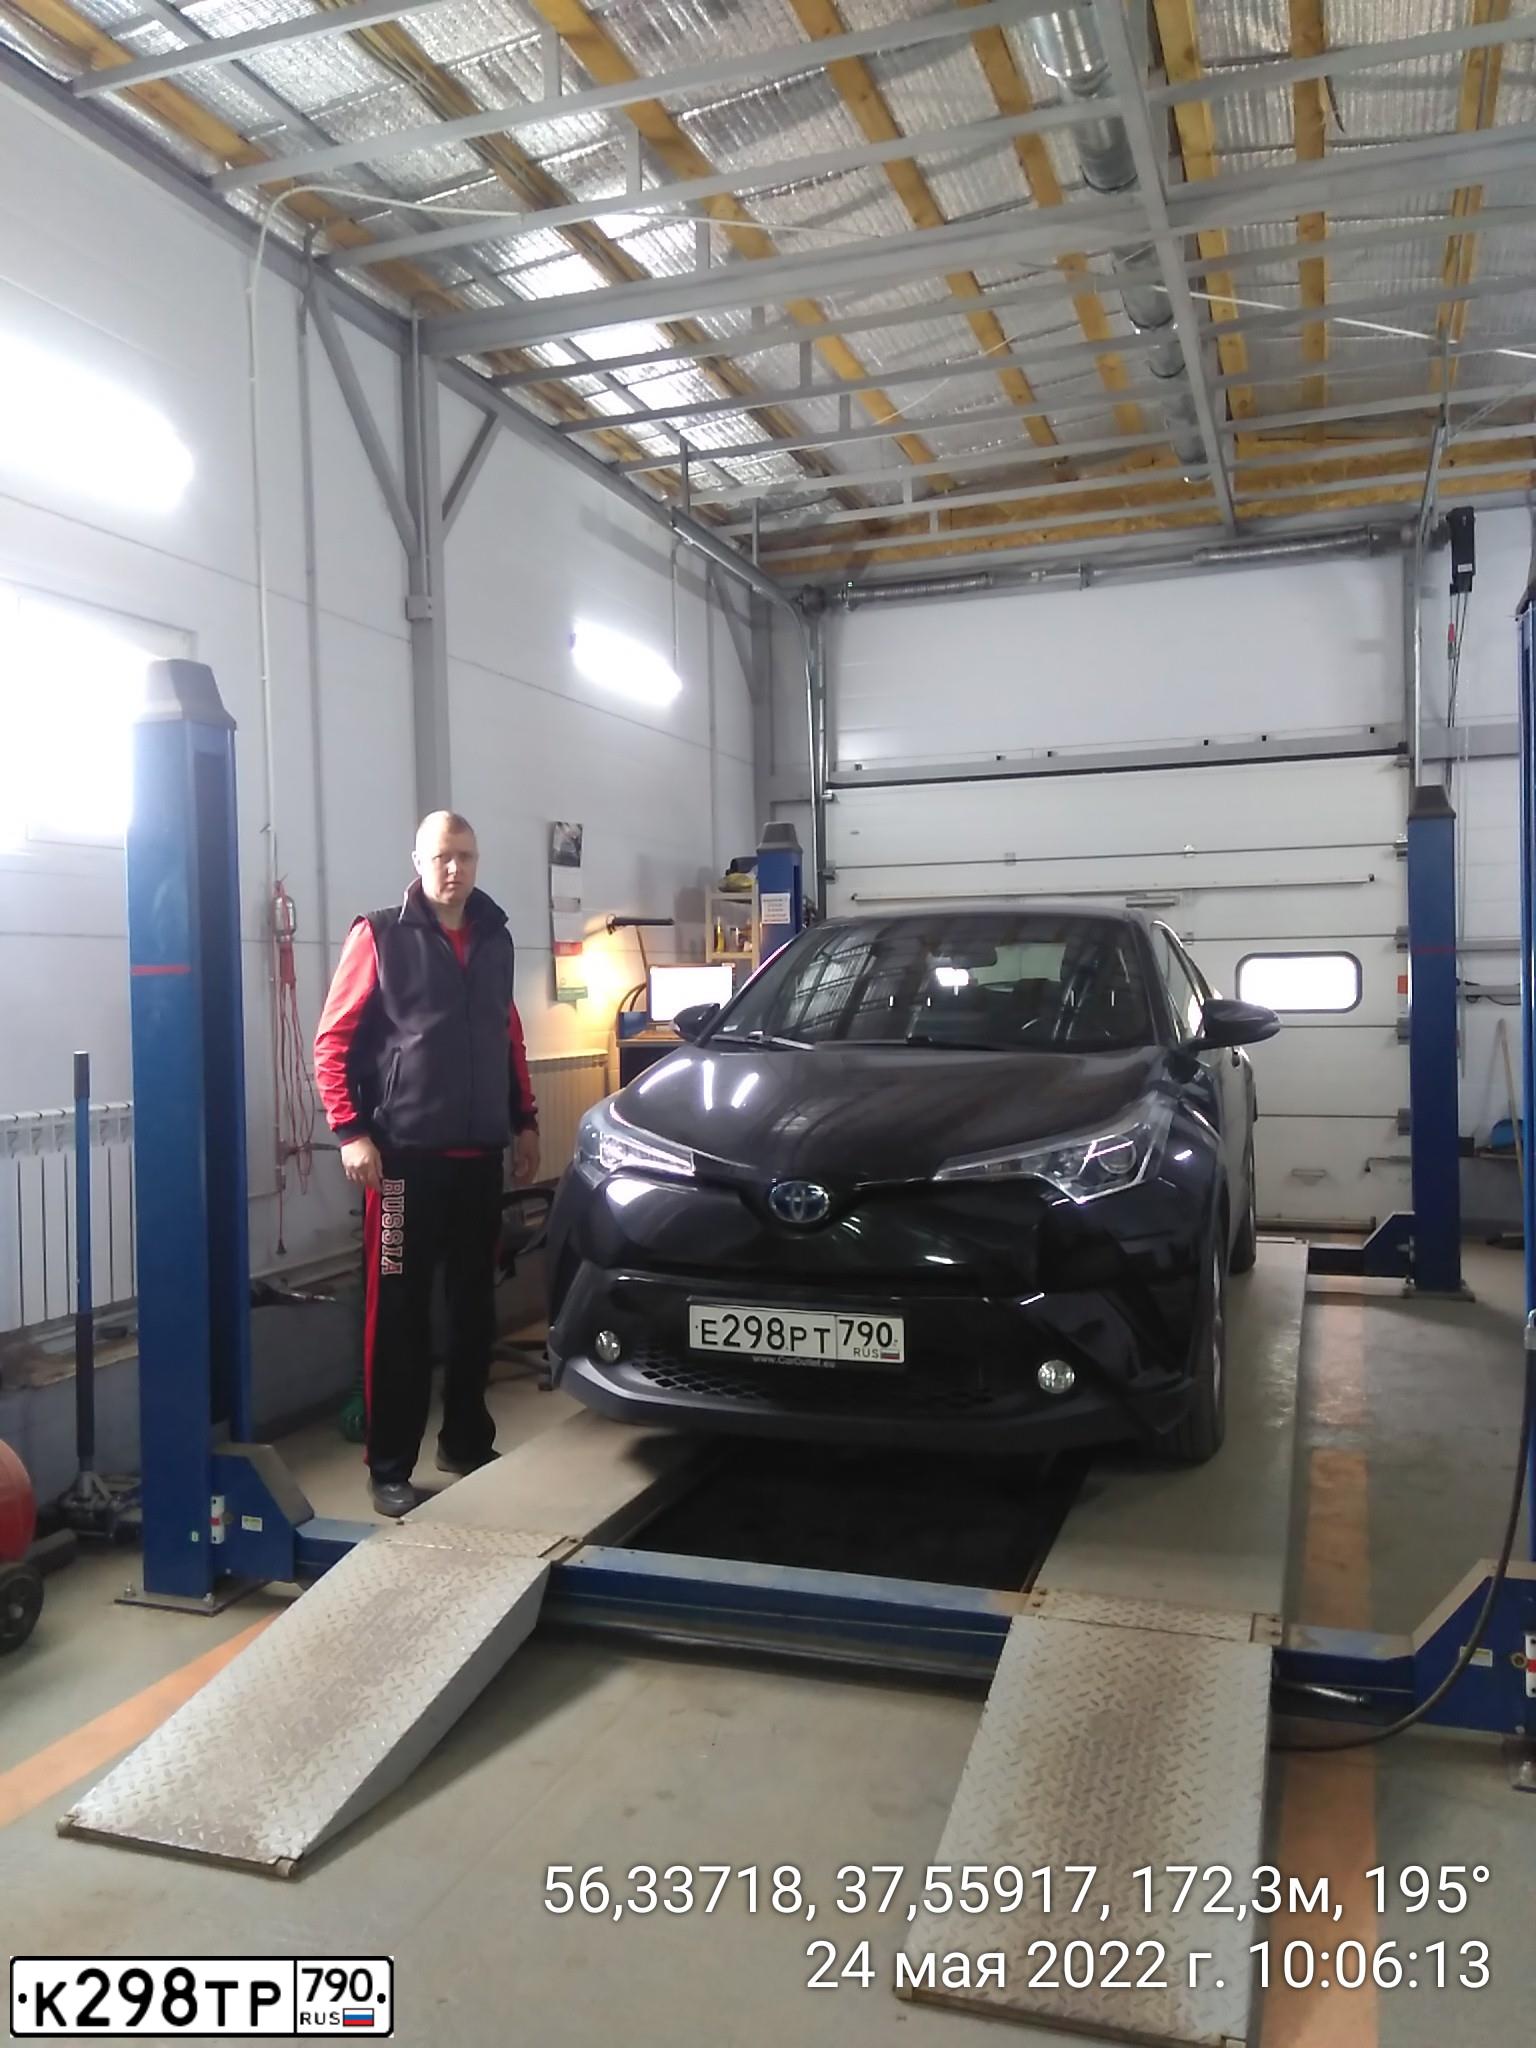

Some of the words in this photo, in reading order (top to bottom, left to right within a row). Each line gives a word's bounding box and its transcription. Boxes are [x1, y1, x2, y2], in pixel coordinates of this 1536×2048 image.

[381, 1179, 405, 1275] RUSSIA
[838, 1319, 893, 1348] 790
[853, 1347, 879, 1359] RUS
